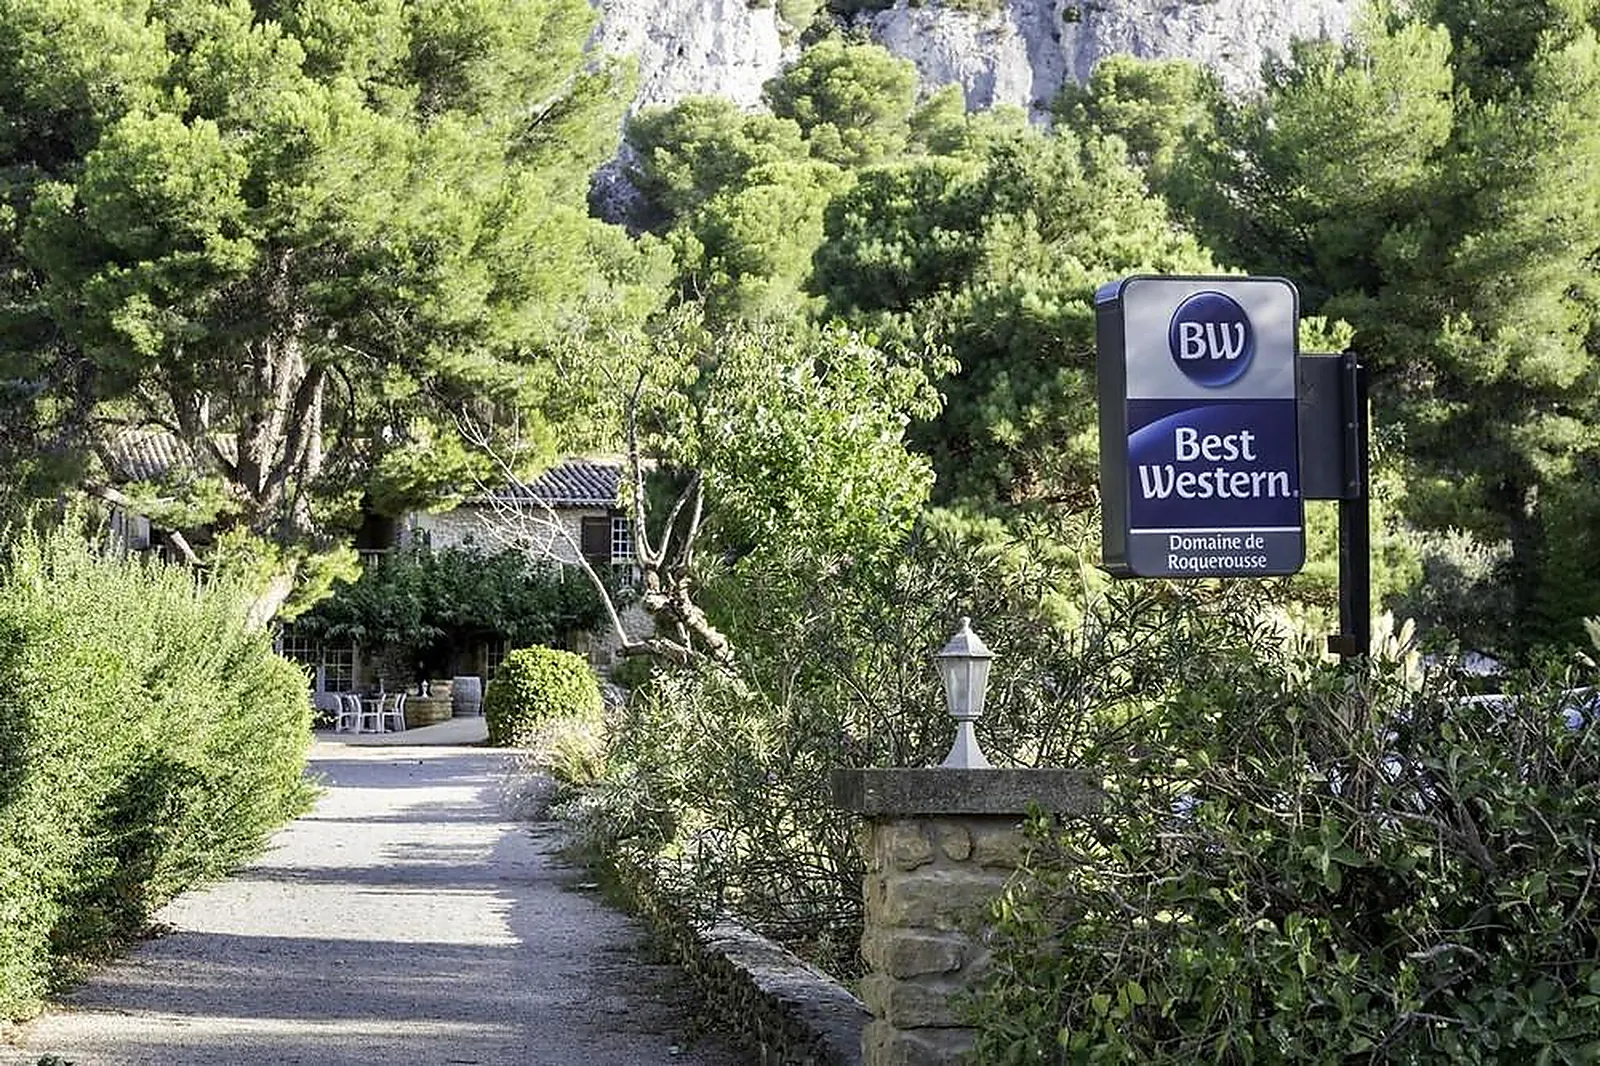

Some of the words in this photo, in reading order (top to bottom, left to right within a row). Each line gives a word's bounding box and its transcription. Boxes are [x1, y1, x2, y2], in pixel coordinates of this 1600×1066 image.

[1179, 322, 1244, 359] BW
[1175, 428, 1256, 462] Best
[1170, 535, 1241, 550] Domaine
[1246, 534, 1264, 550] de
[1168, 554, 1267, 572] Roquerousse
